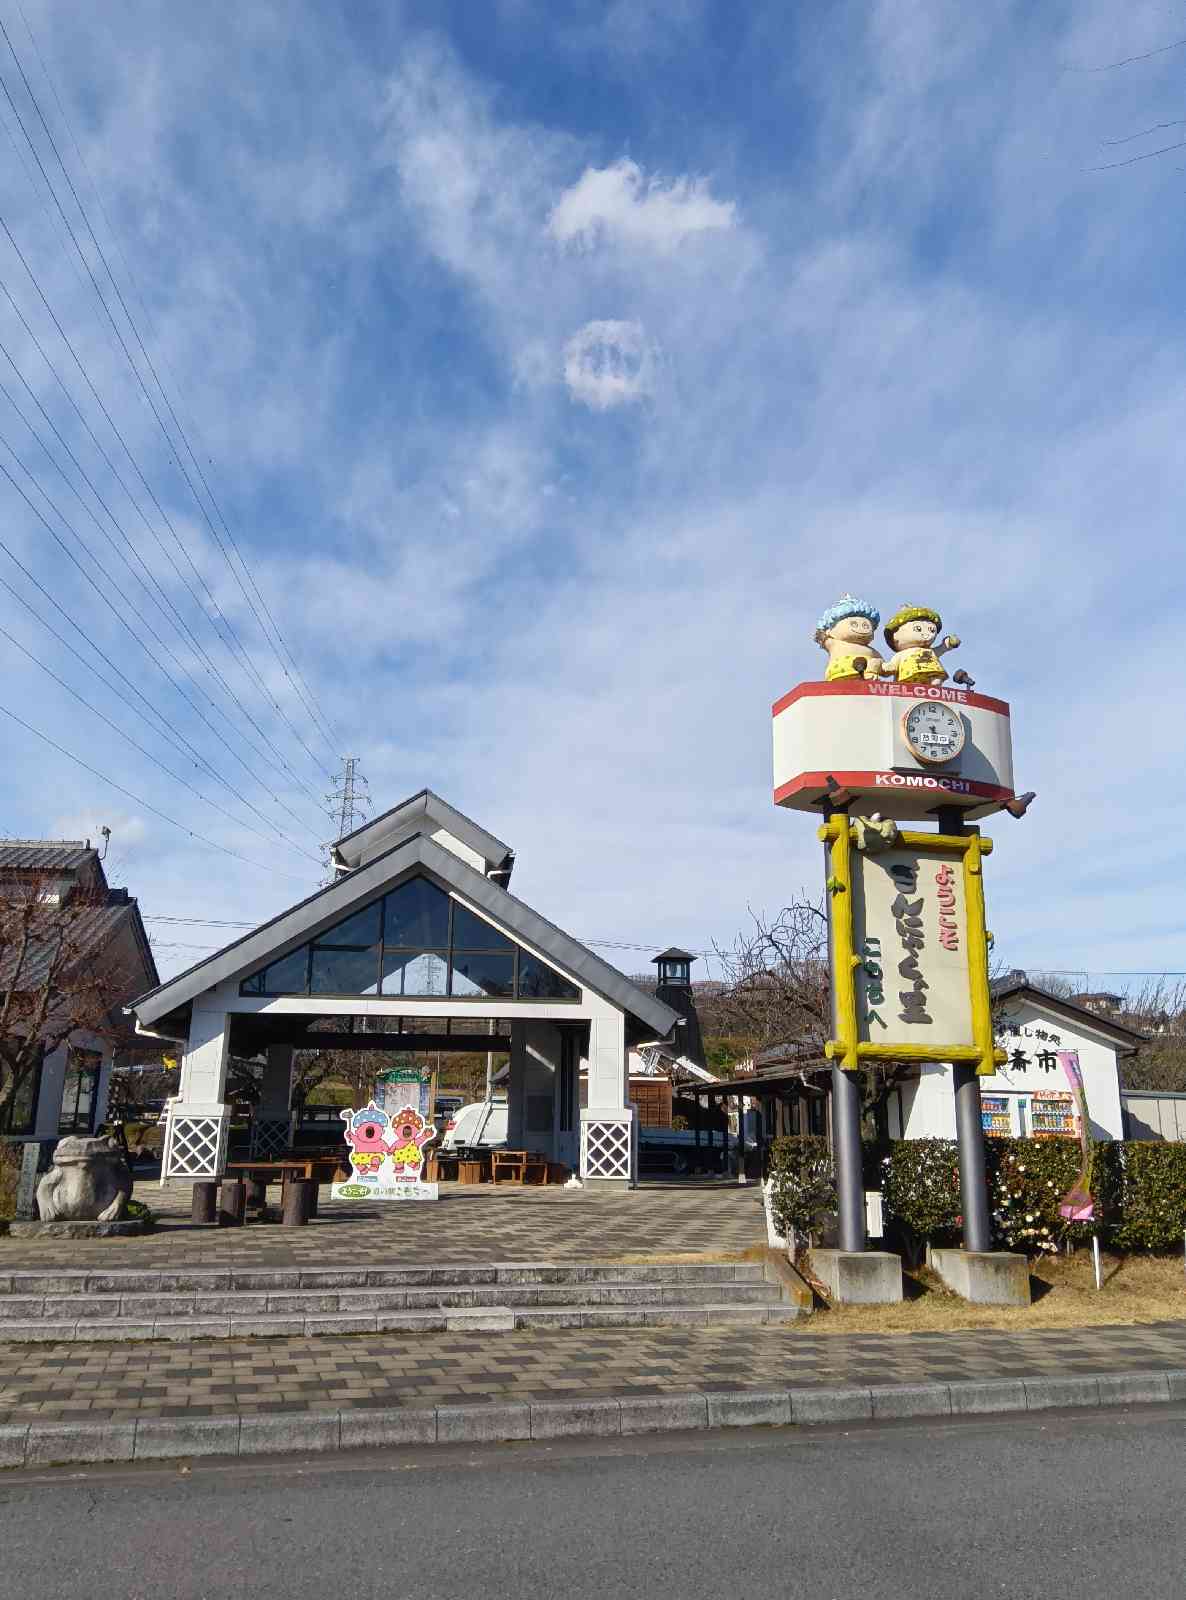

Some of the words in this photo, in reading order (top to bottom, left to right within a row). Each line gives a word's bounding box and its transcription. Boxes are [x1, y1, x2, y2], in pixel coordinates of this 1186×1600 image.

[868, 683, 967, 702] WELCOME
[875, 774, 971, 793] KOMOCHI
[935, 864, 960, 952] ようこそ
[863, 937, 888, 1030] こもちへ
